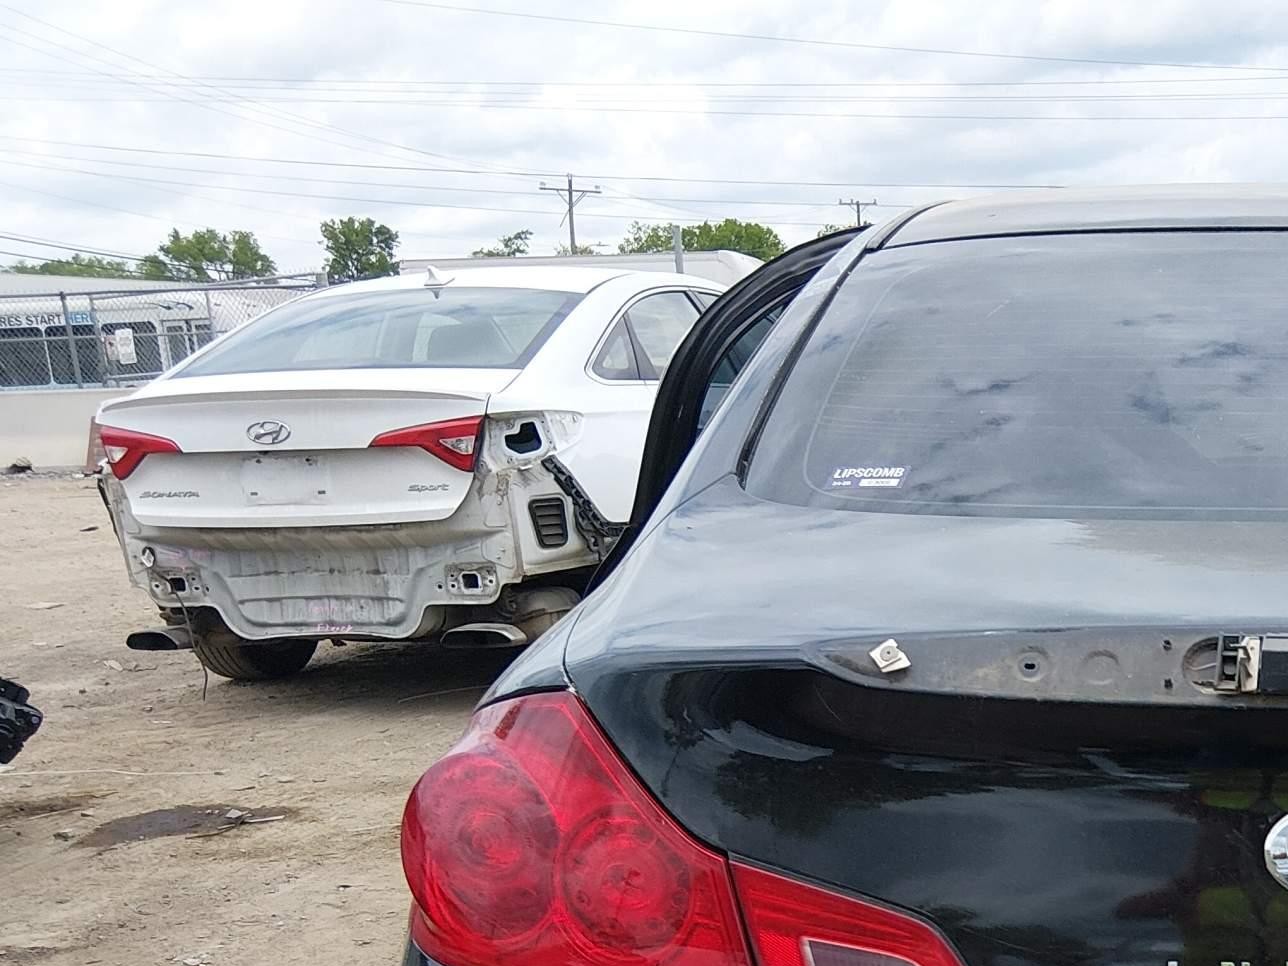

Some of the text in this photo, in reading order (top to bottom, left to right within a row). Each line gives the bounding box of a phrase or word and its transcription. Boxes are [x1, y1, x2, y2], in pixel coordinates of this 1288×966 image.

[25, 312, 63, 326] START
[833, 467, 905, 479] LIPSCOMB
[407, 483, 449, 493] Sport
